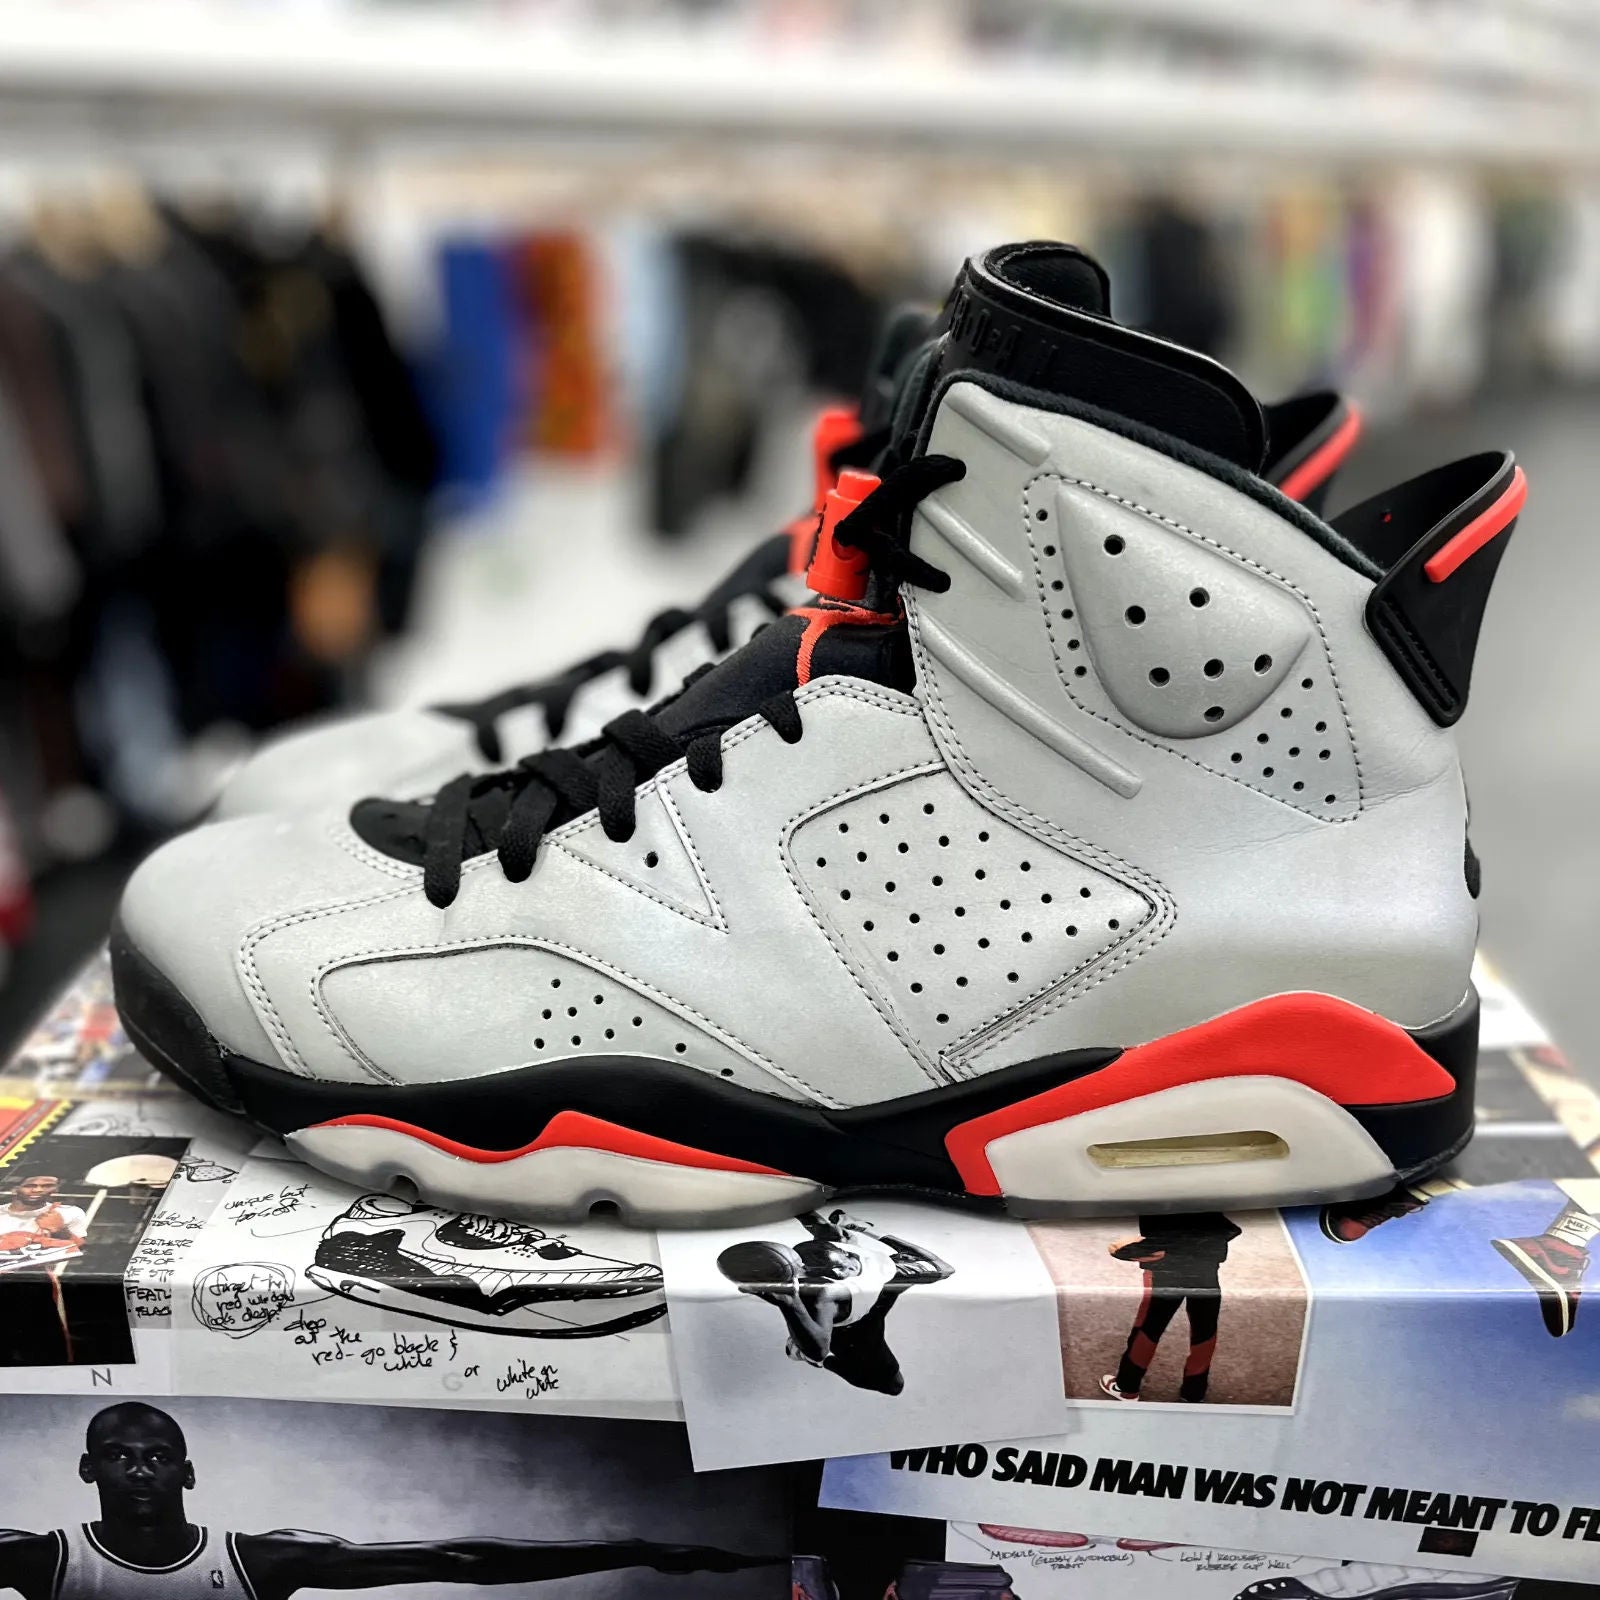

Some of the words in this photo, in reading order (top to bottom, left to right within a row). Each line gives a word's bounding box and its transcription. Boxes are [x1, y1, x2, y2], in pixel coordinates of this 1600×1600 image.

[216, 1298, 242, 1317] red
[329, 1326, 362, 1344] the
[393, 1332, 439, 1355] black
[384, 1352, 432, 1371] white
[464, 1364, 480, 1378] or
[91, 1367, 112, 1387] N
[497, 1358, 535, 1392] white
[890, 1443, 988, 1478] WHO
[992, 1447, 1088, 1488] SAID
[1089, 1458, 1188, 1499] MAN
[1194, 1468, 1277, 1509] WAS
[1280, 1477, 1367, 1516] NOT
[1363, 1486, 1507, 1531] MEANT
[1510, 1501, 1560, 1538] TO
[1562, 1507, 1600, 1543] FL
